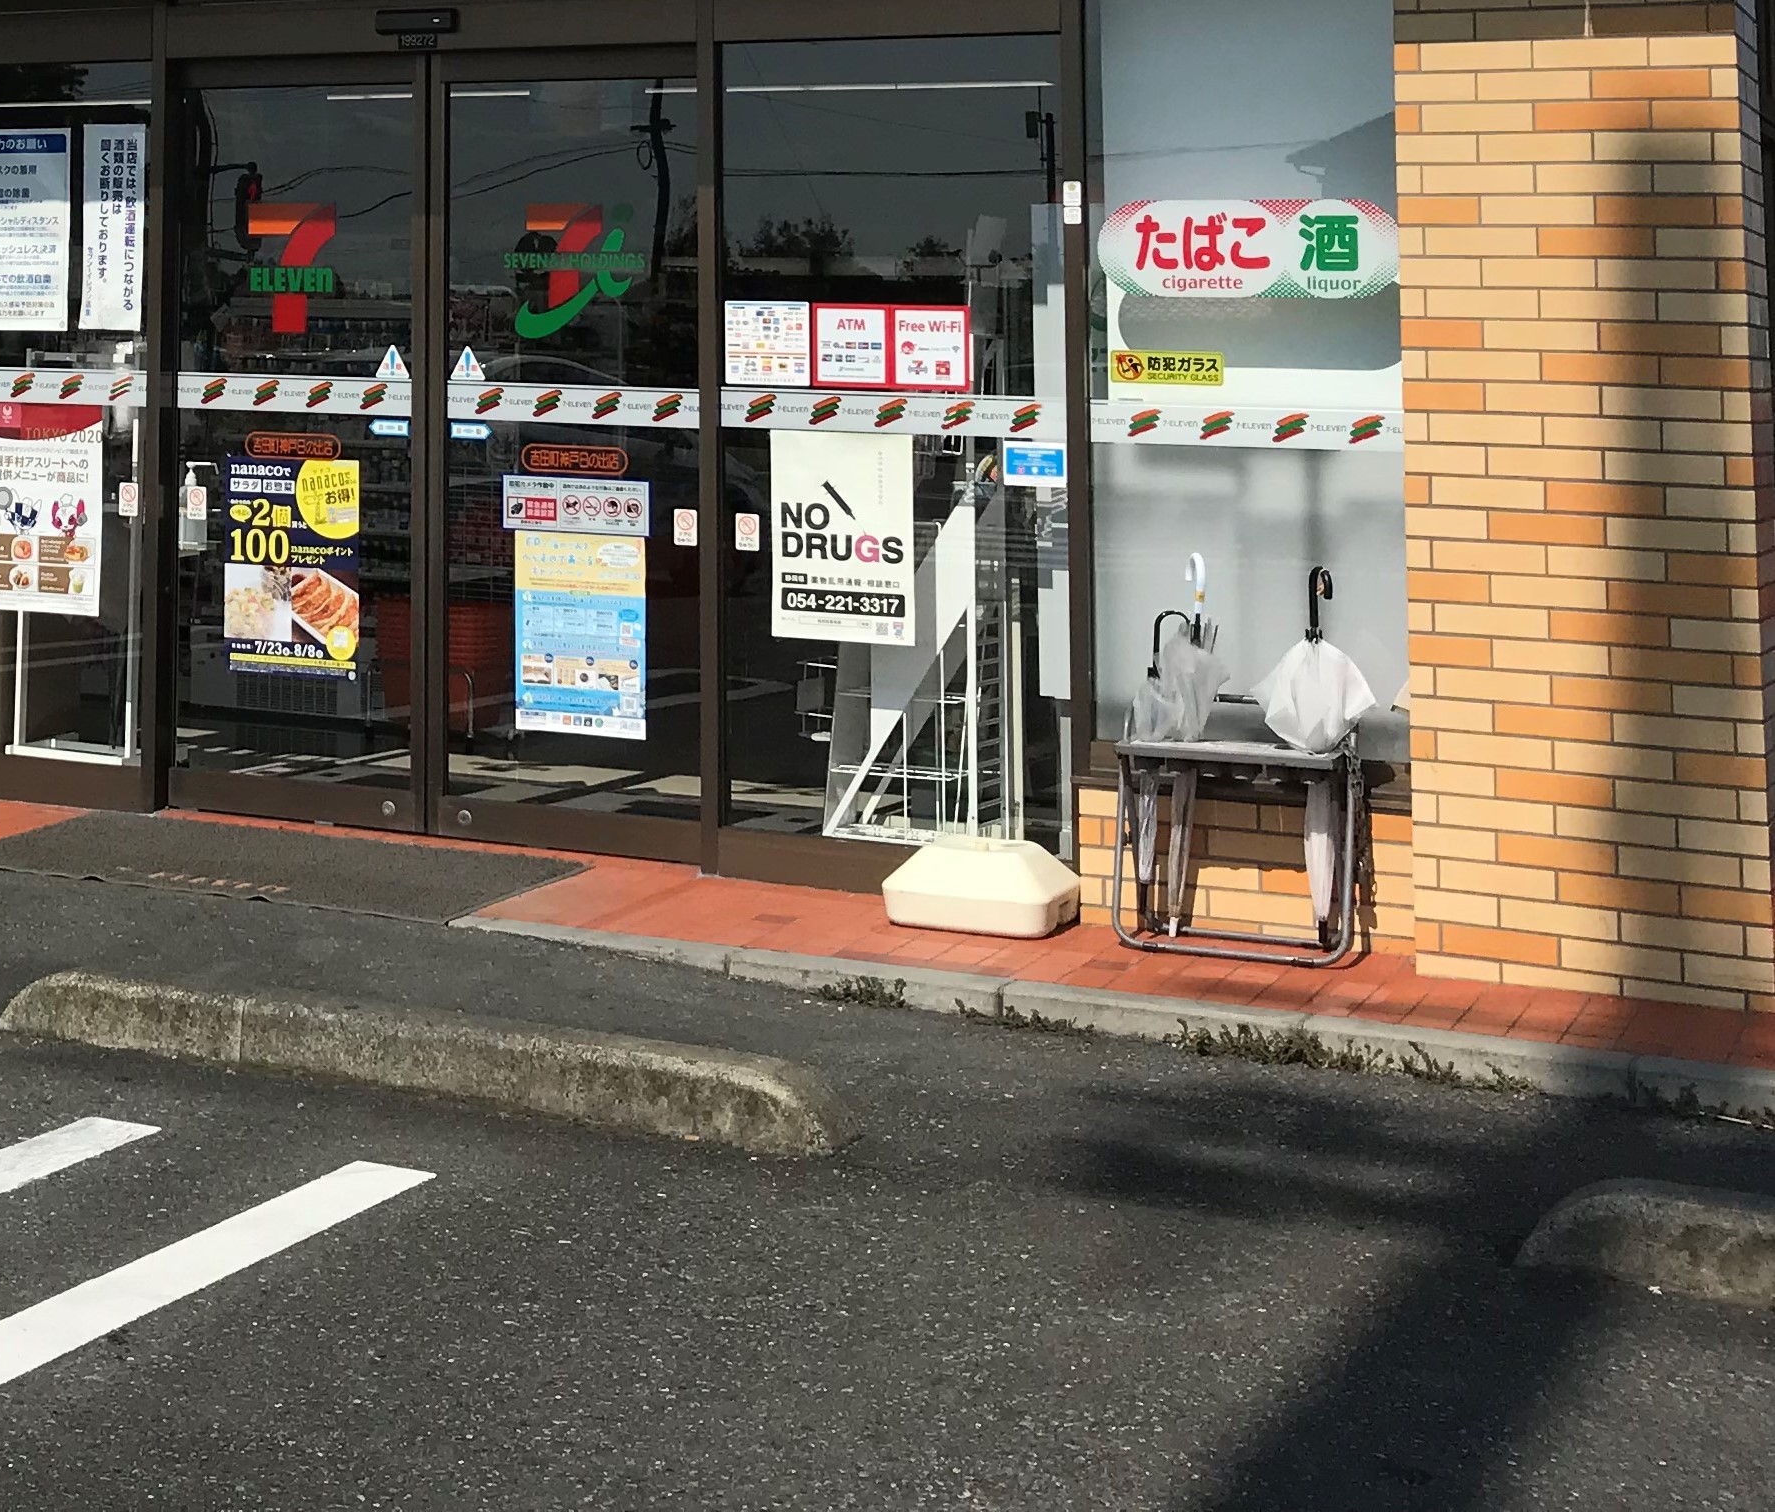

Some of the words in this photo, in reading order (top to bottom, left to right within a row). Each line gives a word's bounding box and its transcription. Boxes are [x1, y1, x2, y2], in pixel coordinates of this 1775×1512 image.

[1136, 212, 1270, 271] たばこ
[1299, 214, 1359, 271] 酒
[1162, 275, 1243, 292] cigarette
[1307, 276, 1361, 293] liquor
[837, 319, 866, 330] ATM
[899, 320, 925, 332] Free
[928, 321, 962, 333] Wi-Fi
[1147, 356, 1219, 372] 防犯ガラス
[1191, 374, 1219, 382] GLASS
[71, 429, 103, 443] 2020
[230, 463, 292, 477] nanacoで
[233, 480, 259, 490] サラダ
[781, 502, 830, 530] NO
[230, 529, 289, 564] 100
[782, 531, 904, 564] DRUGS
[786, 592, 899, 614] 054-221-3317
